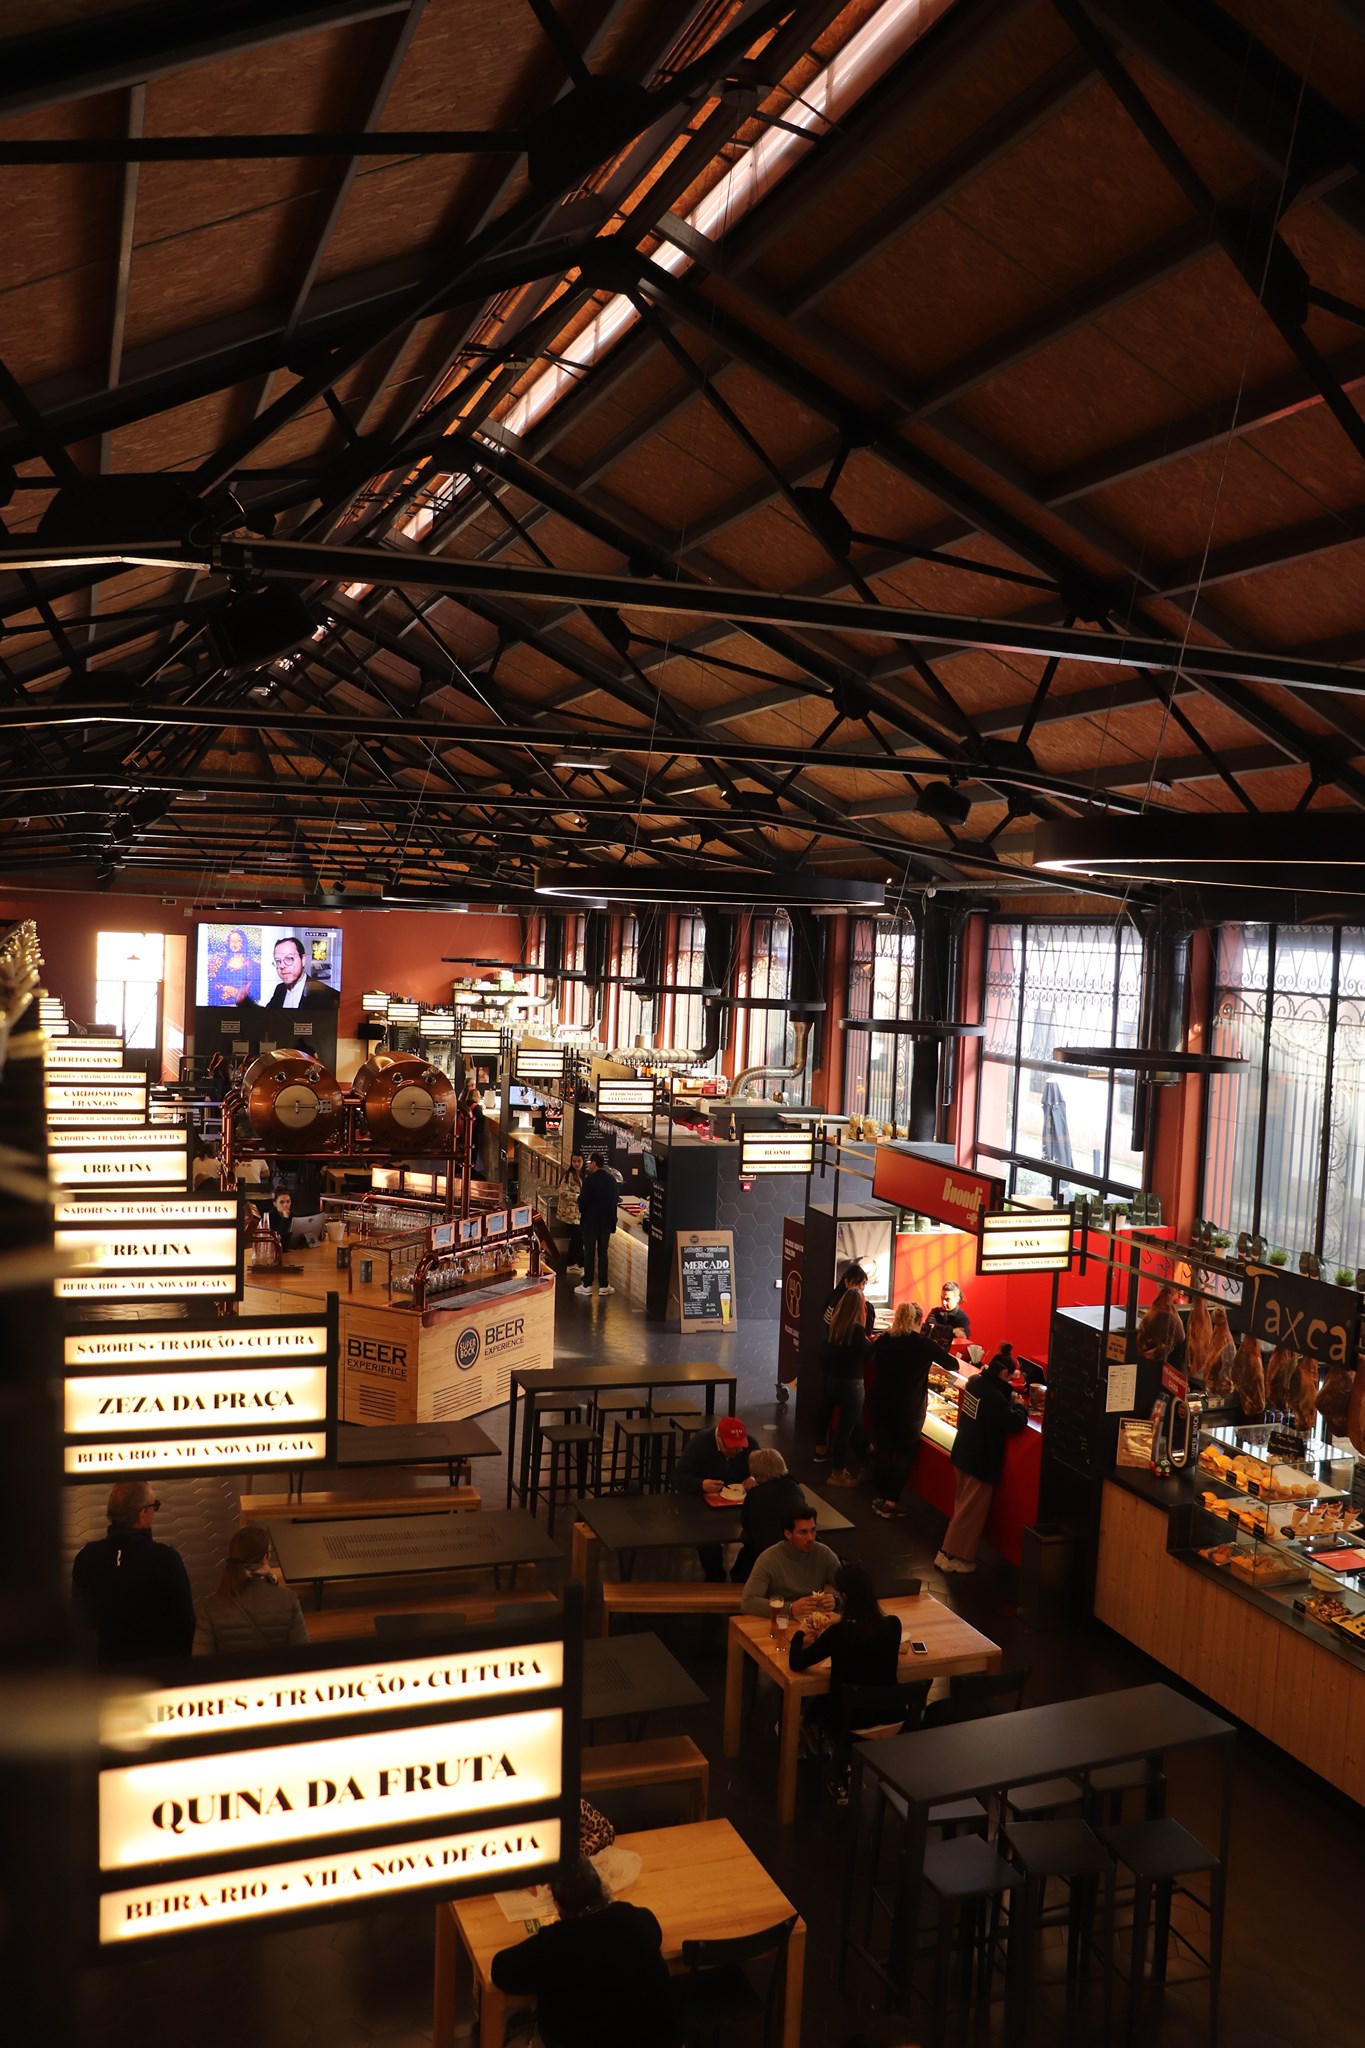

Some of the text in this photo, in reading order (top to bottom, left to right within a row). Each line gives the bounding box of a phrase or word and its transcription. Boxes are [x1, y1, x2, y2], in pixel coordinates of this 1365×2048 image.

[96, 1133, 138, 1142] TRADIÇÃO
[83, 1163, 152, 1174] URBALINA
[63, 1204, 228, 1215] SABORES TRADIÇÃO CULTURA
[1013, 1239, 1041, 1247] TAXCA
[684, 1259, 729, 1270] MERCADO
[1246, 1265, 1347, 1363] Taxca
[485, 1318, 524, 1346] BEER
[76, 1335, 315, 1355] SABORES TRADIÇÃO CULTURA
[347, 1338, 407, 1367] BEER
[459, 1338, 476, 1350] SUPER
[460, 1346, 475, 1359] BOCK
[484, 1337, 524, 1357] EXPERIENCE
[346, 1358, 407, 1377] EXPERIENCE
[98, 1389, 295, 1415] ZEZA DA PRAÇA
[77, 1440, 314, 1464] BEIRA-RIO VILA NOVA DE GAIA
[270, 1673, 406, 1708] TRADIÇÃO
[428, 1658, 542, 1688] CULTURA
[152, 1752, 518, 1834] QUINA DA FRUTA
[125, 1834, 541, 1922] BEIRA-RIO VILA NOVA DE GAIA
